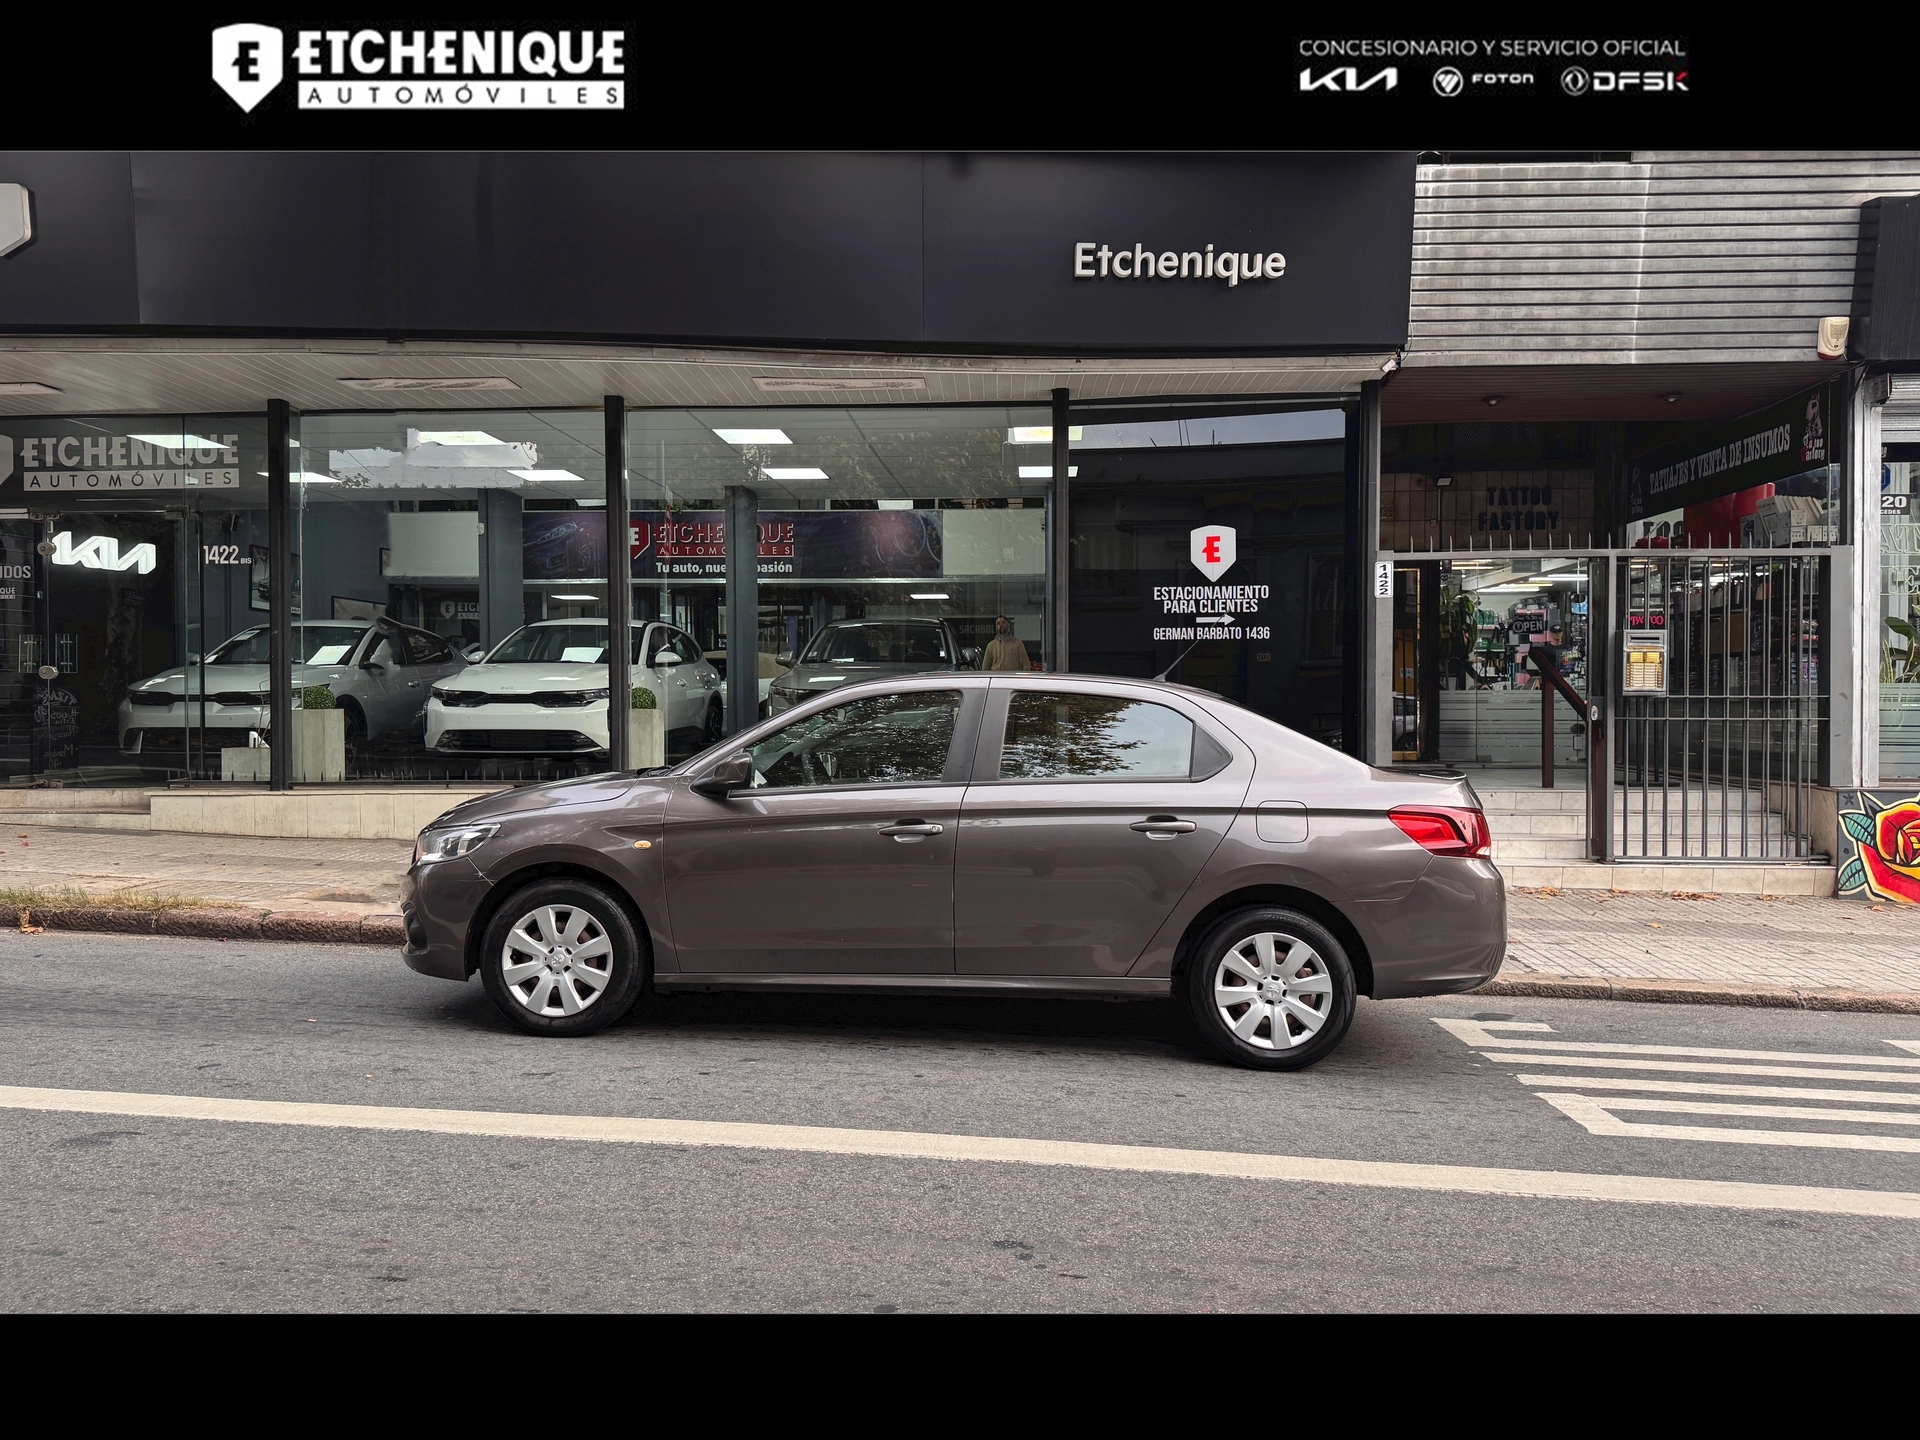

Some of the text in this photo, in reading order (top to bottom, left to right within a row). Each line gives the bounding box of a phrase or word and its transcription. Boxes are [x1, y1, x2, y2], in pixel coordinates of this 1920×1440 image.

[1074, 242, 1287, 287] Etchenique
[20, 434, 239, 468] ETCHENIQUE
[1650, 423, 1791, 495] TATUAJES Y VENTA DE INSUMOS
[29, 470, 232, 489] AUTOMÓVILES
[1486, 487, 1552, 506] TATTOO
[1880, 496, 1907, 508] 20
[1478, 511, 1559, 531] FACTORY
[654, 523, 794, 544] ETCHEQUE
[51, 531, 157, 575] KIA
[203, 545, 252, 565] 1422 BIS
[659, 547, 791, 555] AUTOMLES
[656, 562, 670, 573] Tu
[672, 562, 703, 575] auto,
[706, 563, 727, 573] nue
[1379, 564, 1389, 596] 1422
[1153, 585, 1270, 600] ESTACIONAMIENTO
[1163, 599, 1259, 614] PARA CLIENTES
[959, 624, 998, 635] SACABOL
[1513, 620, 1543, 633] OPEN
[1630, 615, 1664, 626] TAOO
[1153, 626, 1271, 640] GERMAN BARBATO 1436
